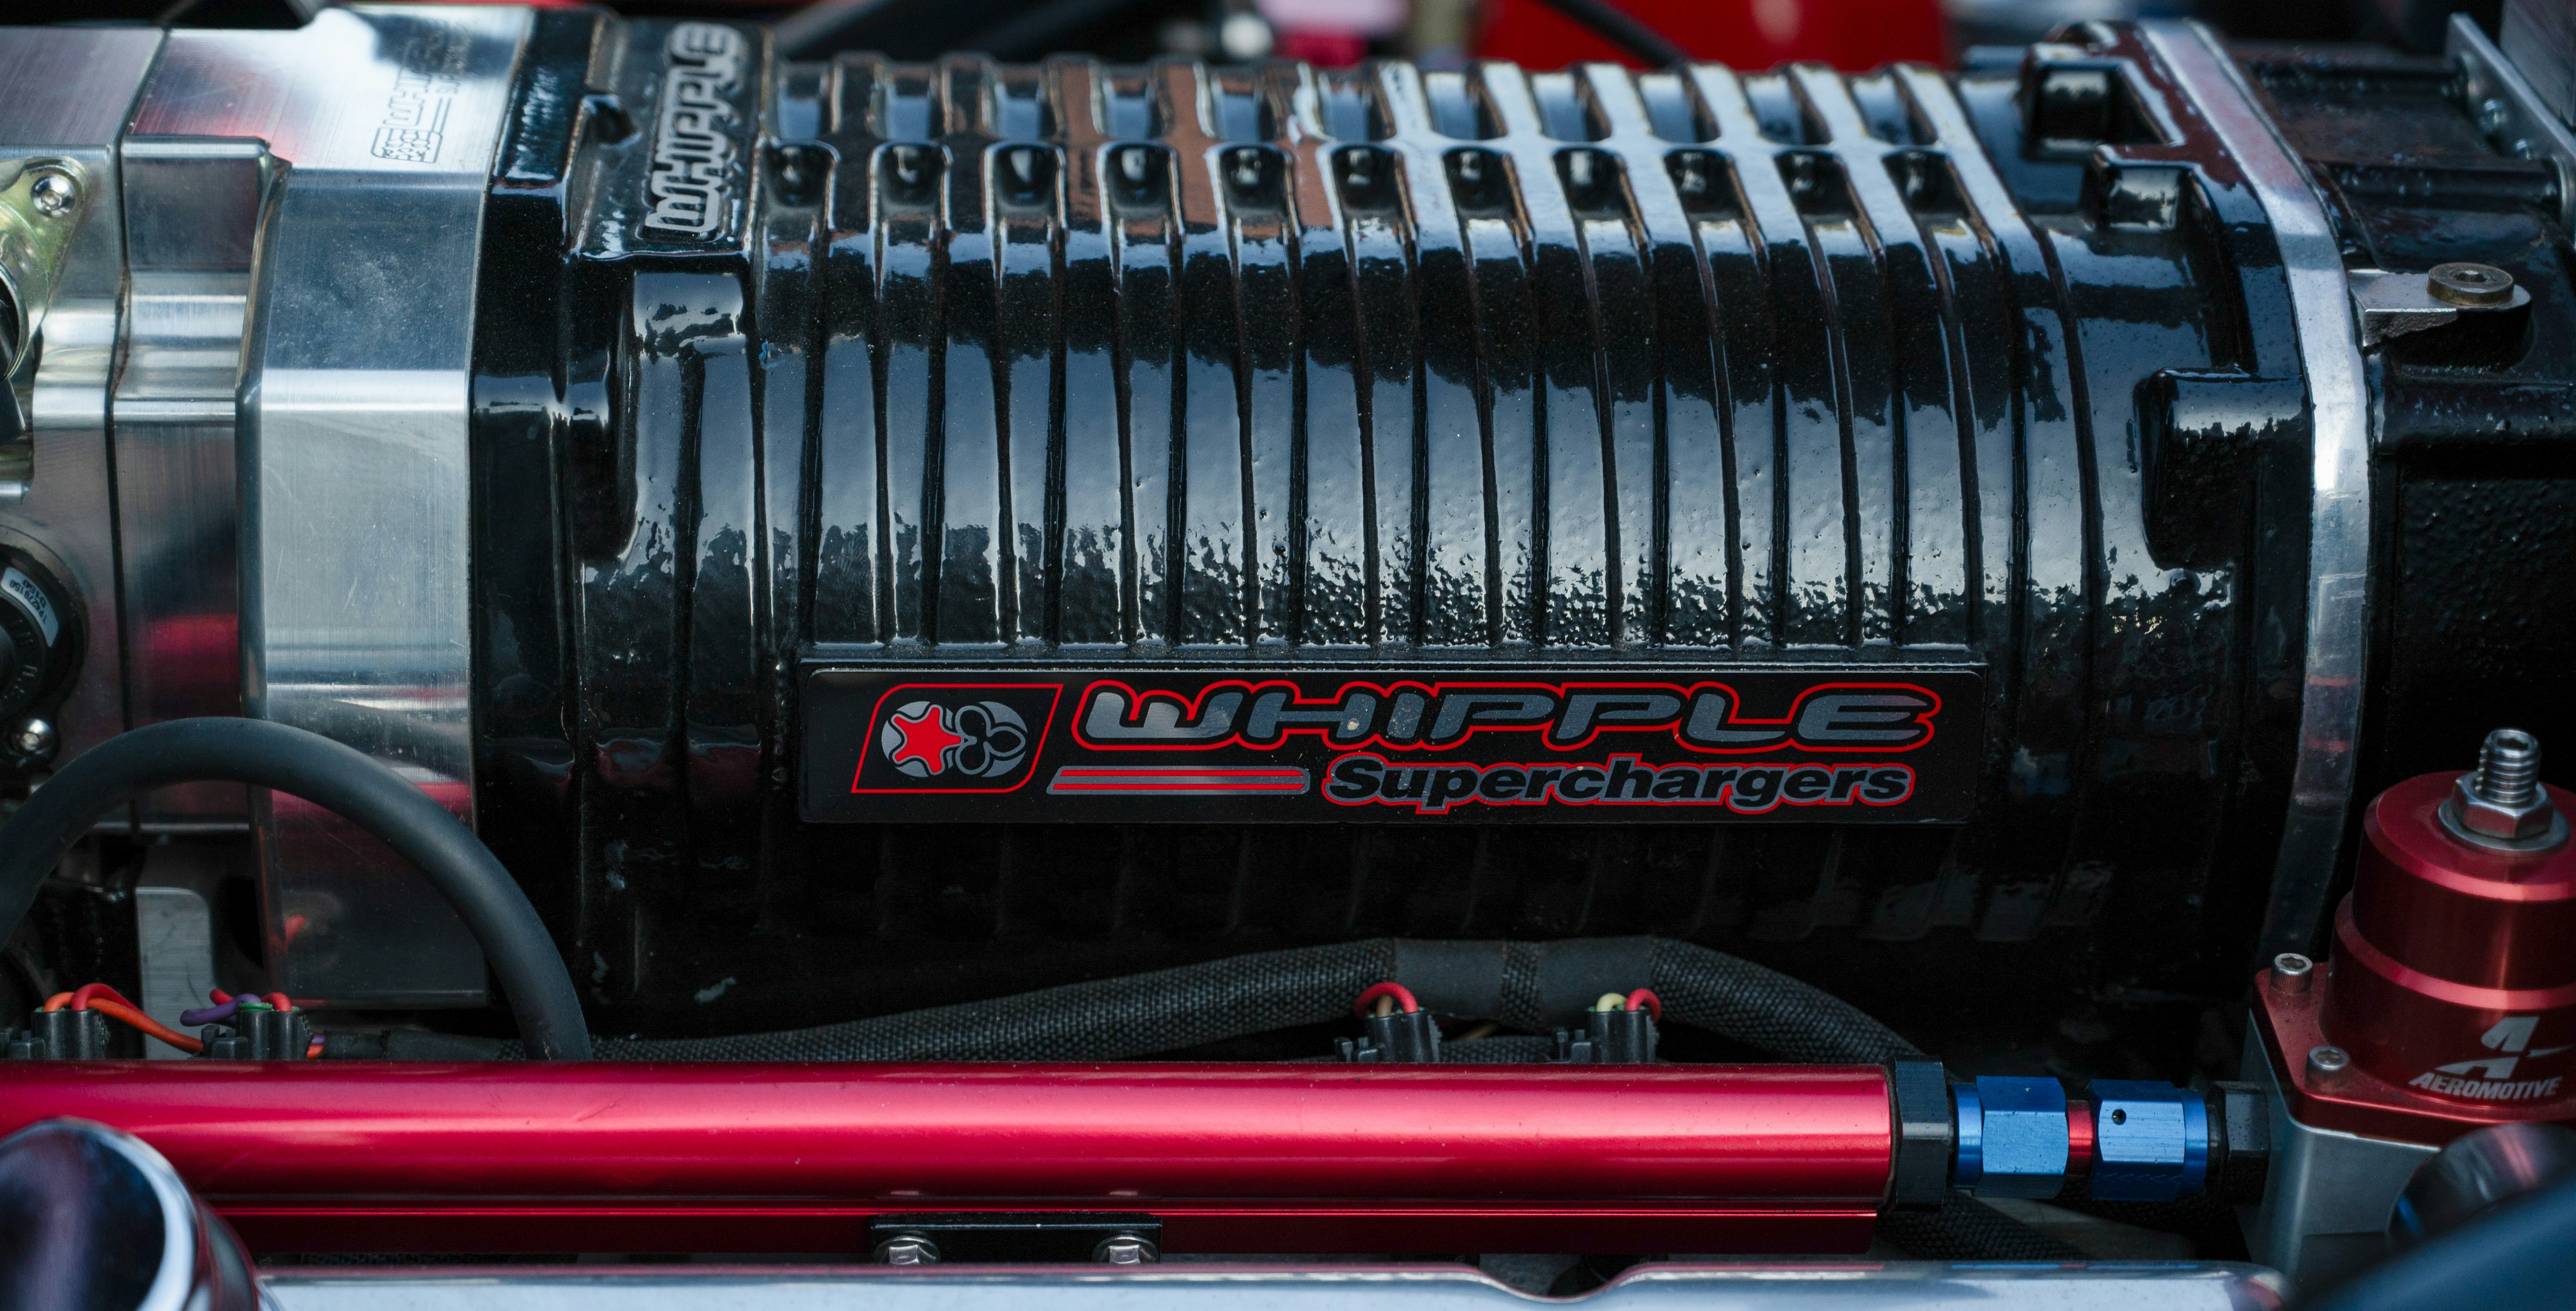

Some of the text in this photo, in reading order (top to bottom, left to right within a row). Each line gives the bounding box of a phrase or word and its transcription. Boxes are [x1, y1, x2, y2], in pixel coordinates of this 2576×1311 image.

[645, 21, 740, 233] WHIPPLE
[1077, 684, 1936, 748] WHIPPLE
[1326, 755, 1911, 812] Superchargers
[2408, 1072, 2563, 1100] AEROMOTIVE
